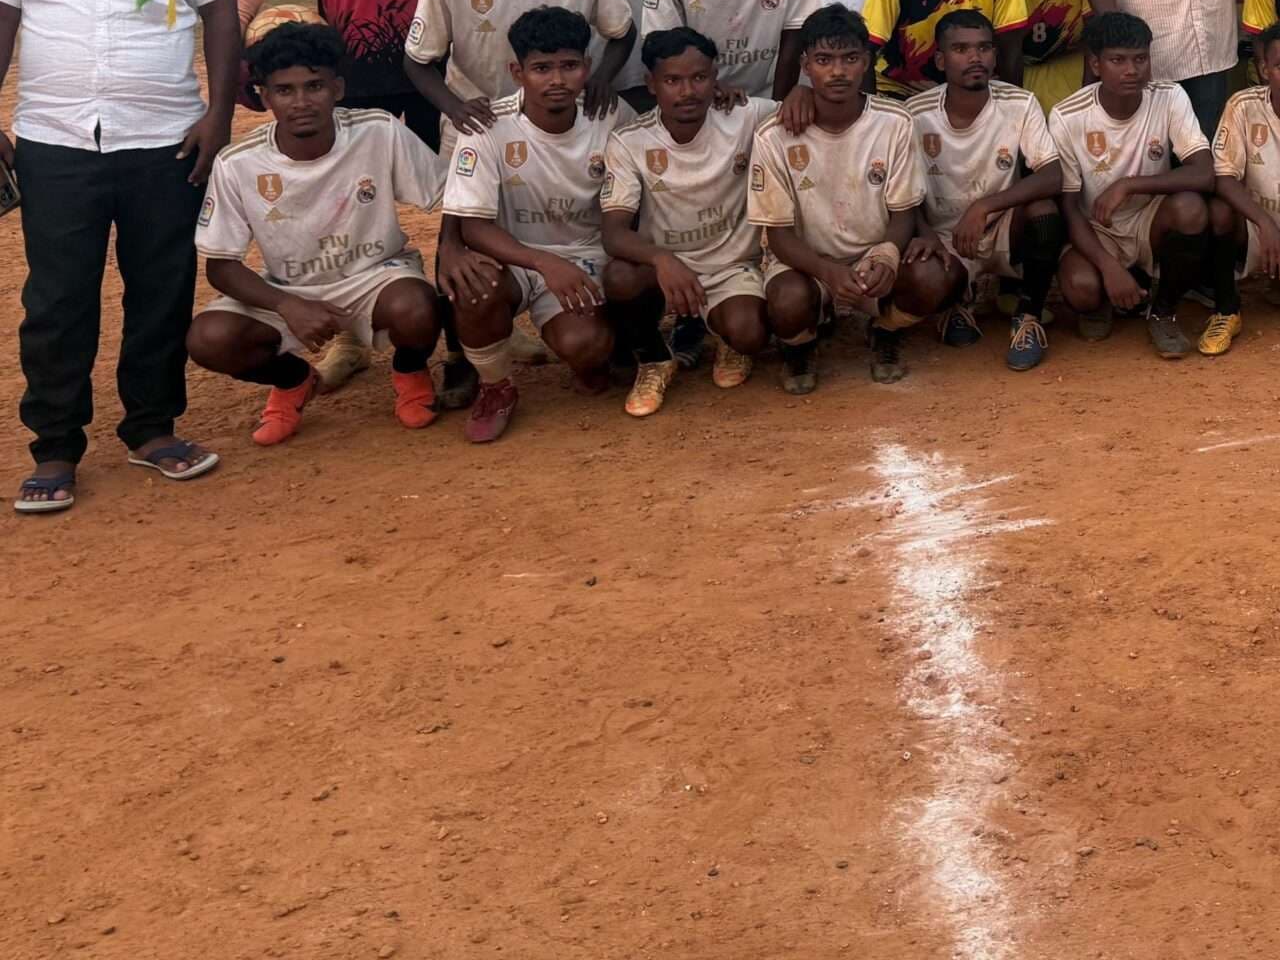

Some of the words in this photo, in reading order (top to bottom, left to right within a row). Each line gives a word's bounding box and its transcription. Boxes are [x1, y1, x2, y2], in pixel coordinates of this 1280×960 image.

[1032, 22, 1047, 43] 8
[726, 36, 750, 49] Fly
[714, 46, 779, 65] mirates
[318, 233, 350, 250] Fly
[284, 239, 385, 279] Emirates
